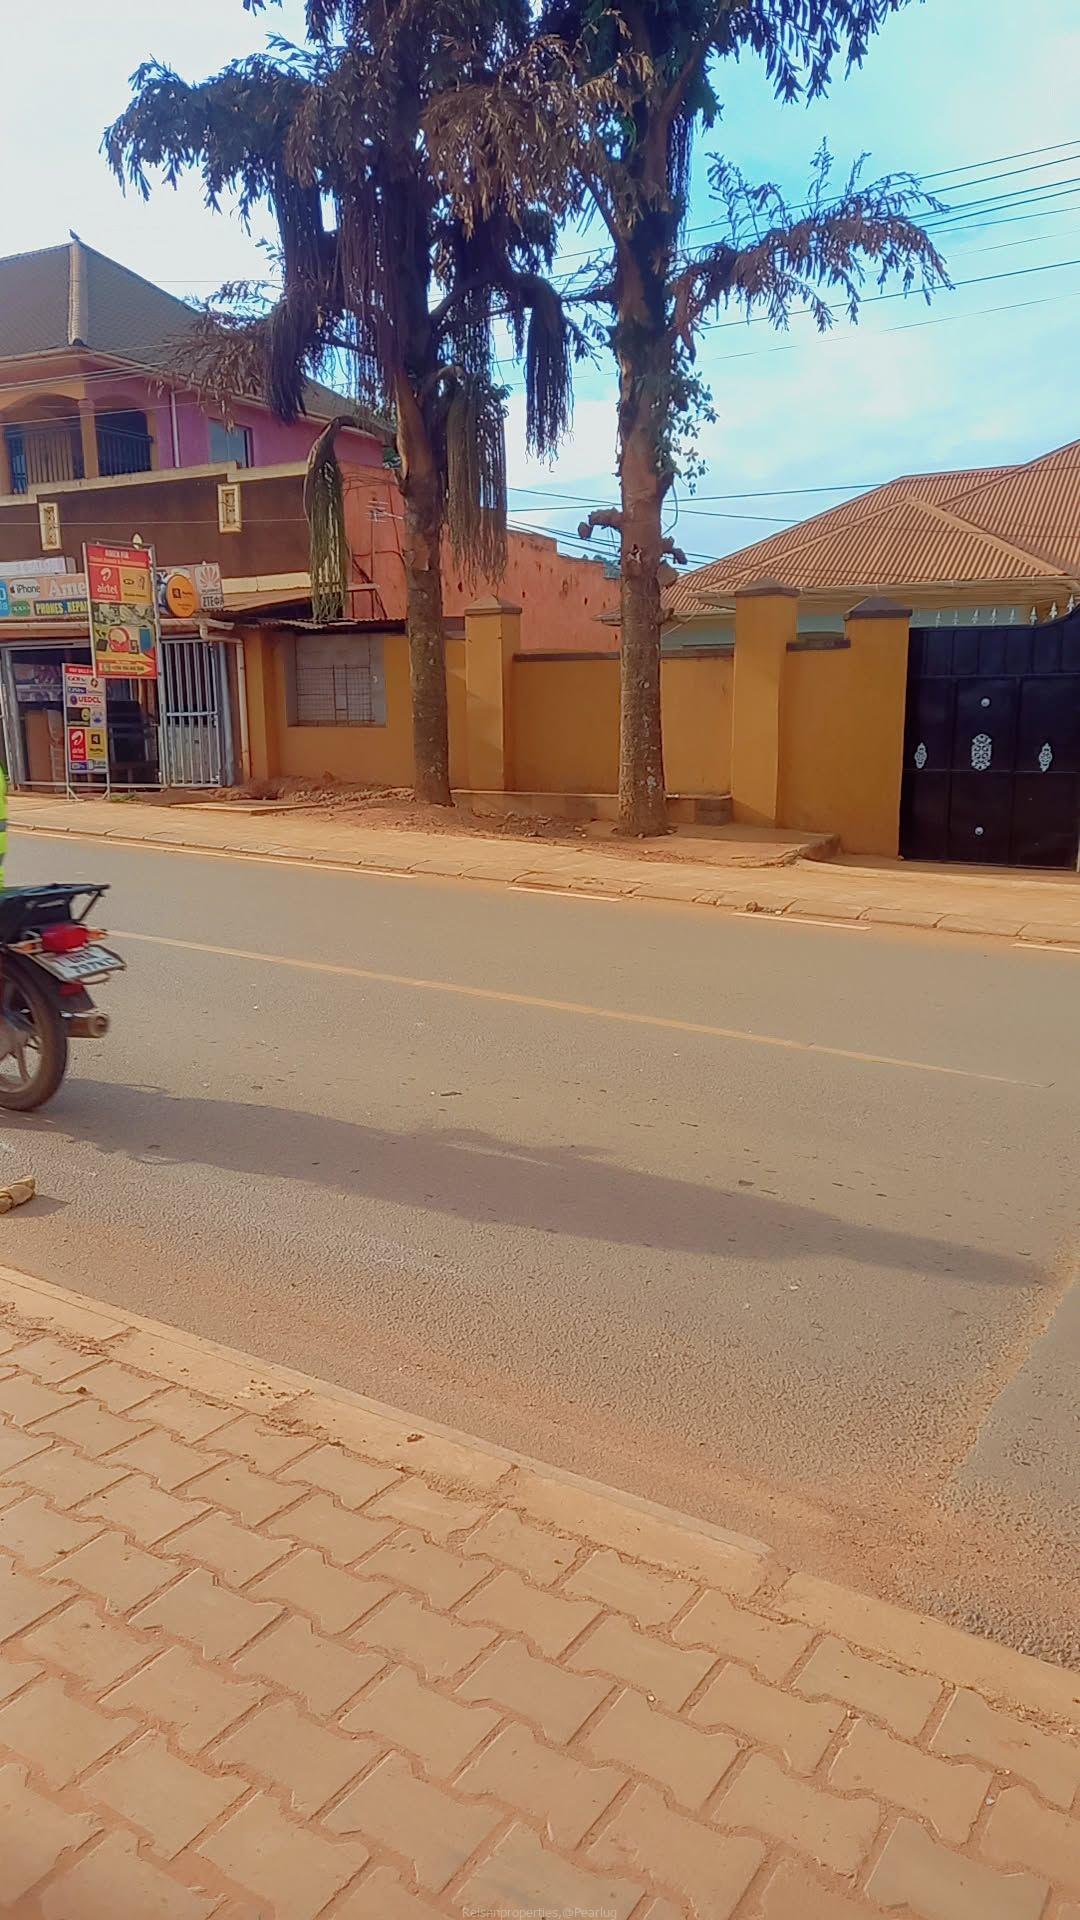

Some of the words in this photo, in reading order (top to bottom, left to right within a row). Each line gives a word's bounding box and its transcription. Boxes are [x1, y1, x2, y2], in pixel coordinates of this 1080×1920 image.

[17, 584, 40, 594] iPhone
[97, 583, 118, 594] airtel
[36, 602, 64, 615] PHONES
